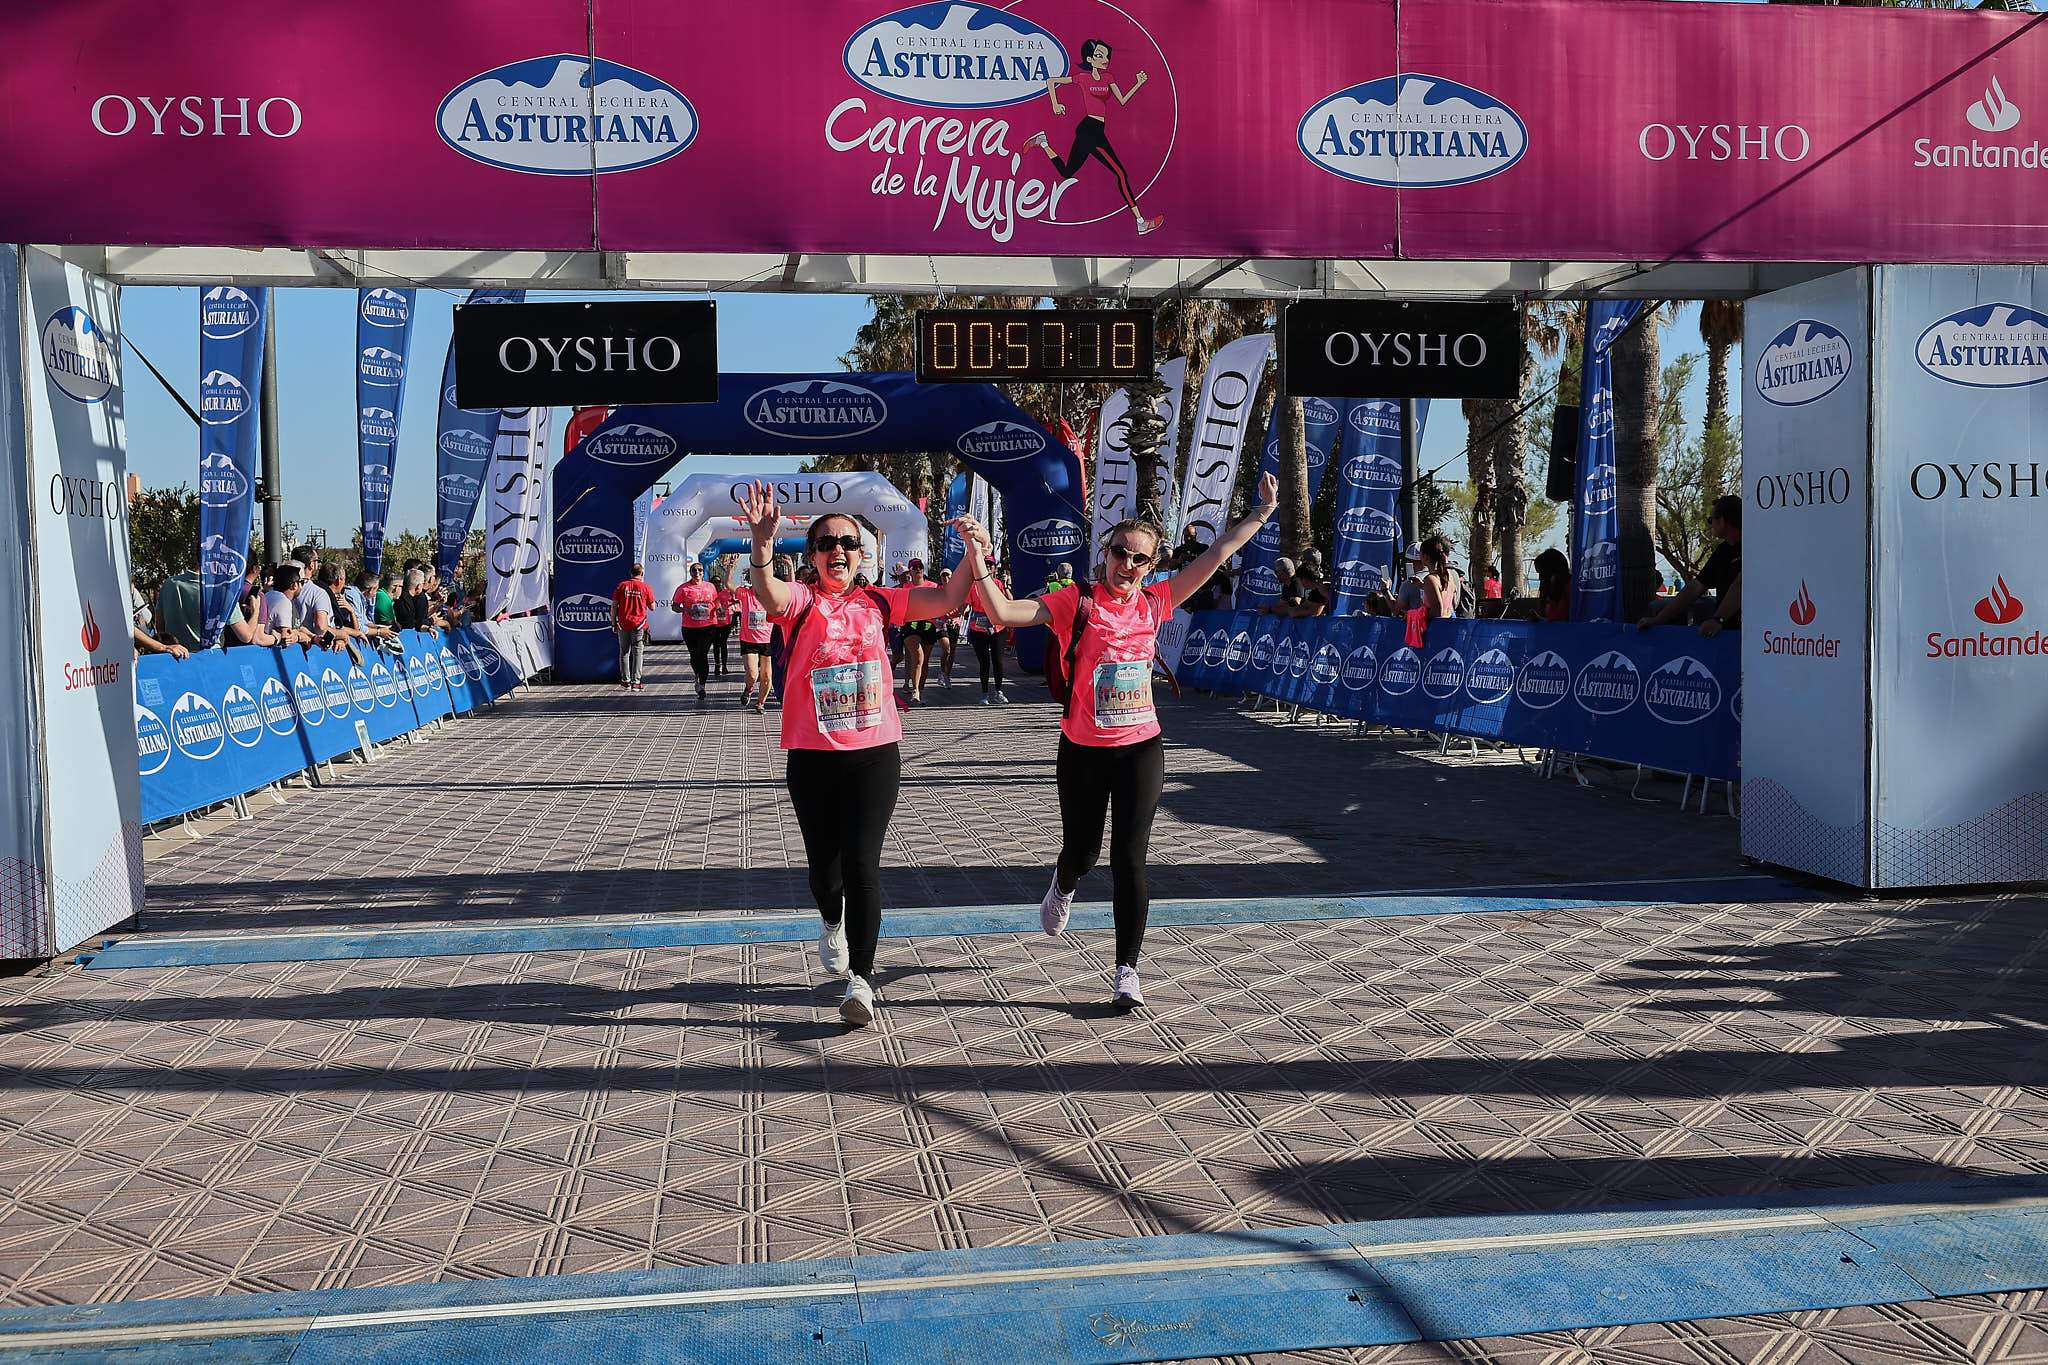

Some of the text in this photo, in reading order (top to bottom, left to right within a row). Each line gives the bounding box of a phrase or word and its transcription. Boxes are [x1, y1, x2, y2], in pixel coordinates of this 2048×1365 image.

[895, 36, 1045, 51] CENTRAL LECHERA
[860, 37, 1050, 83] ASTURIANA
[496, 95, 579, 107] CENTRAL
[90, 94, 303, 138] OYSHO
[456, 97, 679, 144] ASTURIANA
[824, 97, 1011, 156] Carrera
[1351, 112, 1503, 126] CENTRAL LECHERA
[1315, 114, 1510, 158] ASTURIANA
[1638, 122, 1810, 162] OYSHO
[1912, 143, 2048, 169] Santande
[870, 152, 1080, 243] de la Mujer
[933, 321, 1136, 370] 00:57:18
[1324, 331, 1488, 367] OYSHO
[1952, 332, 2048, 342] CENTRAL LECHE
[48, 332, 111, 386] ASTURIANA
[498, 336, 681, 373] OYSHO
[1774, 340, 1842, 363] CENTRAL LECHERA
[1927, 334, 2048, 367] ASTURIAN
[1761, 353, 1845, 392] ASTURIANA
[755, 398, 878, 424] ASTURIANA
[826, 397, 873, 405] LECHERA
[1353, 411, 1400, 431] ASTURIA
[591, 440, 671, 456] ASTURIANA
[964, 437, 1041, 453] ASTURIANA
[1178, 370, 1249, 549] OYSHO
[1757, 467, 1851, 510] OYSHO
[1910, 462, 2048, 501] OYSH
[50, 473, 120, 521] OYSHO
[874, 503, 908, 513] OYSHO
[662, 507, 698, 517] OYSHO
[558, 541, 620, 555] ASTURIANA
[1021, 532, 1081, 549] ASTURIANA
[648, 553, 681, 562] OYSHO
[891, 550, 923, 558] OYSHO
[558, 608, 612, 623] ASTURIAN
[654, 600, 674, 608] YSH
[1763, 630, 1840, 659] Santander
[1926, 630, 2048, 659] Santande
[64, 652, 121, 692] Santander
[1382, 666, 1418, 684] ASTURIANA
[1424, 667, 1461, 687] ASTURIANA
[1469, 666, 1509, 691] ASTURIANA
[1518, 671, 1566, 695] ASTURIANA
[1577, 672, 1635, 701] ASTURIANA
[1647, 677, 1711, 711] ASTURIANA
[228, 709, 262, 734] ASTURIANA
[264, 702, 298, 724] ASTURIANA
[177, 719, 224, 747] ASTURIANA
